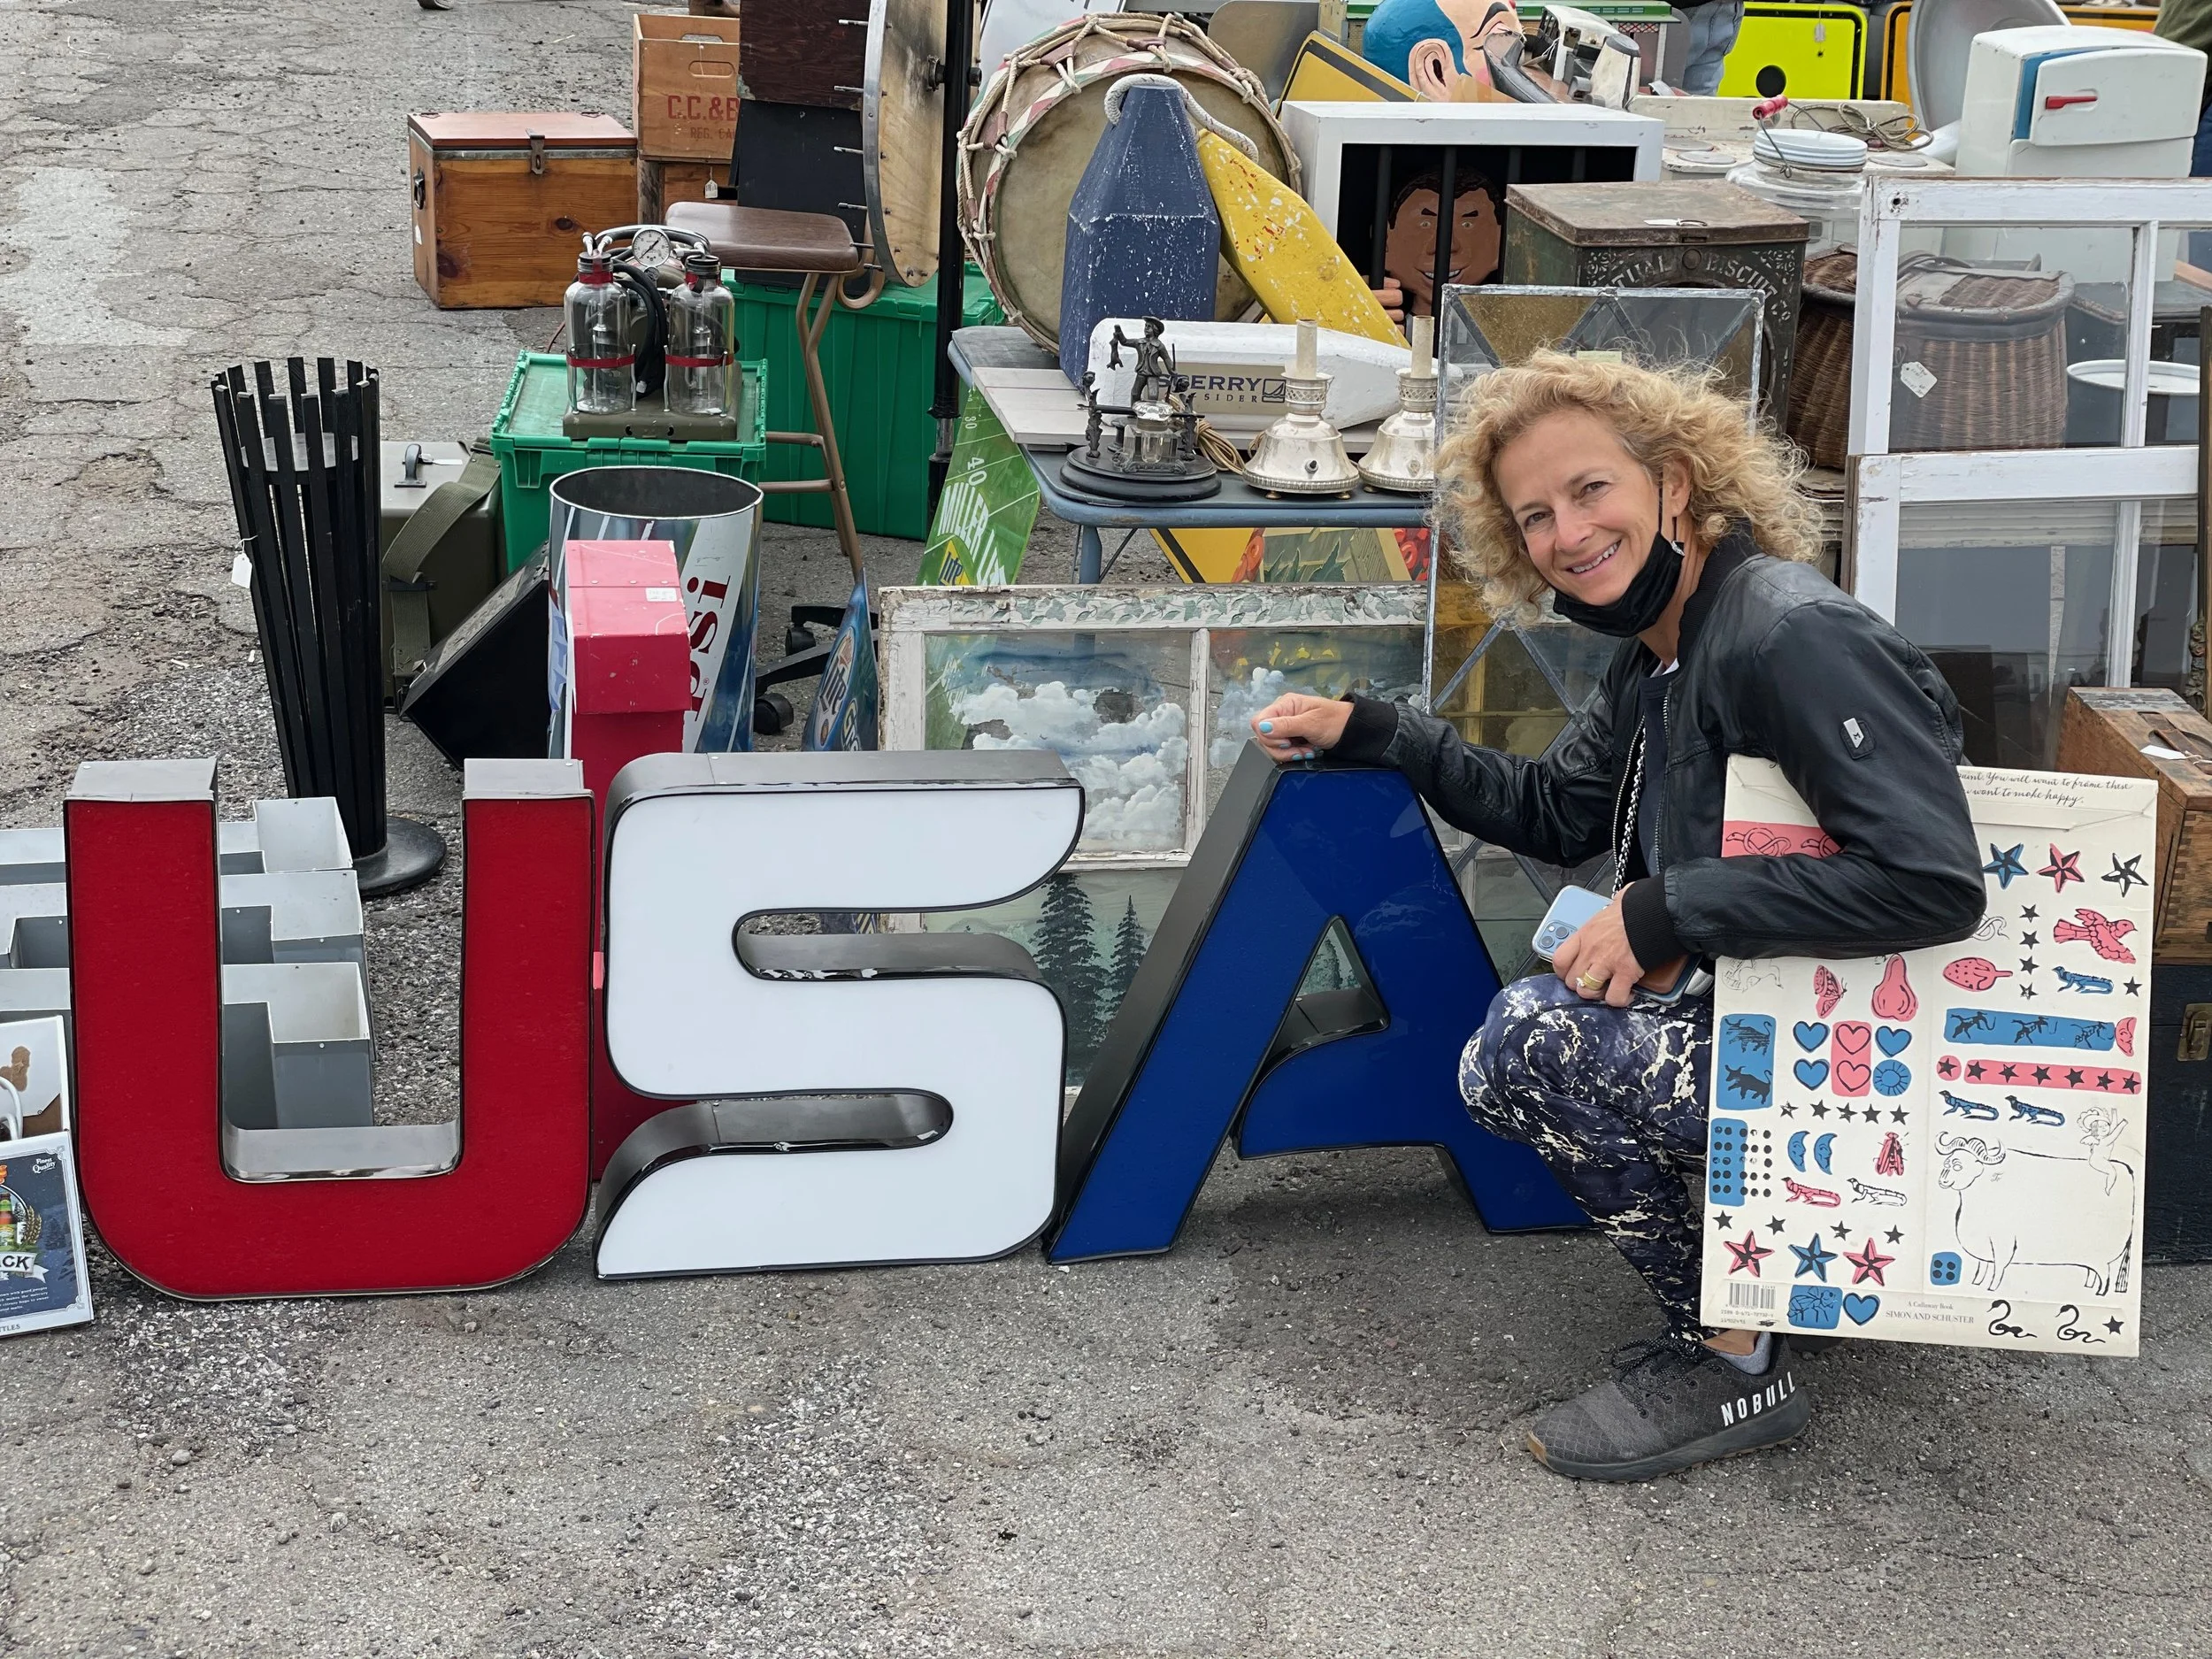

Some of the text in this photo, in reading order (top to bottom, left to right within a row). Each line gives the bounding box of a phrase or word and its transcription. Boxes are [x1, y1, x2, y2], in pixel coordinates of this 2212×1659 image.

[967, 457, 987, 487] 40
[937, 482, 989, 564] MILLER
[1985, 771, 2008, 786] You
[2010, 774, 2032, 785] will
[2033, 778, 2059, 787] want
[2062, 778, 2071, 787] to
[2071, 776, 2102, 790] frame
[2106, 780, 2133, 790] these
[1972, 787, 2001, 796] want
[2002, 787, 2013, 797] to
[2014, 787, 2043, 799] make
[62, 749, 1588, 1305] USA
[0, 1255, 32, 1271] CK
[1886, 1311, 1912, 1320] SIMON
[1932, 1315, 1974, 1325] SCHUSTER
